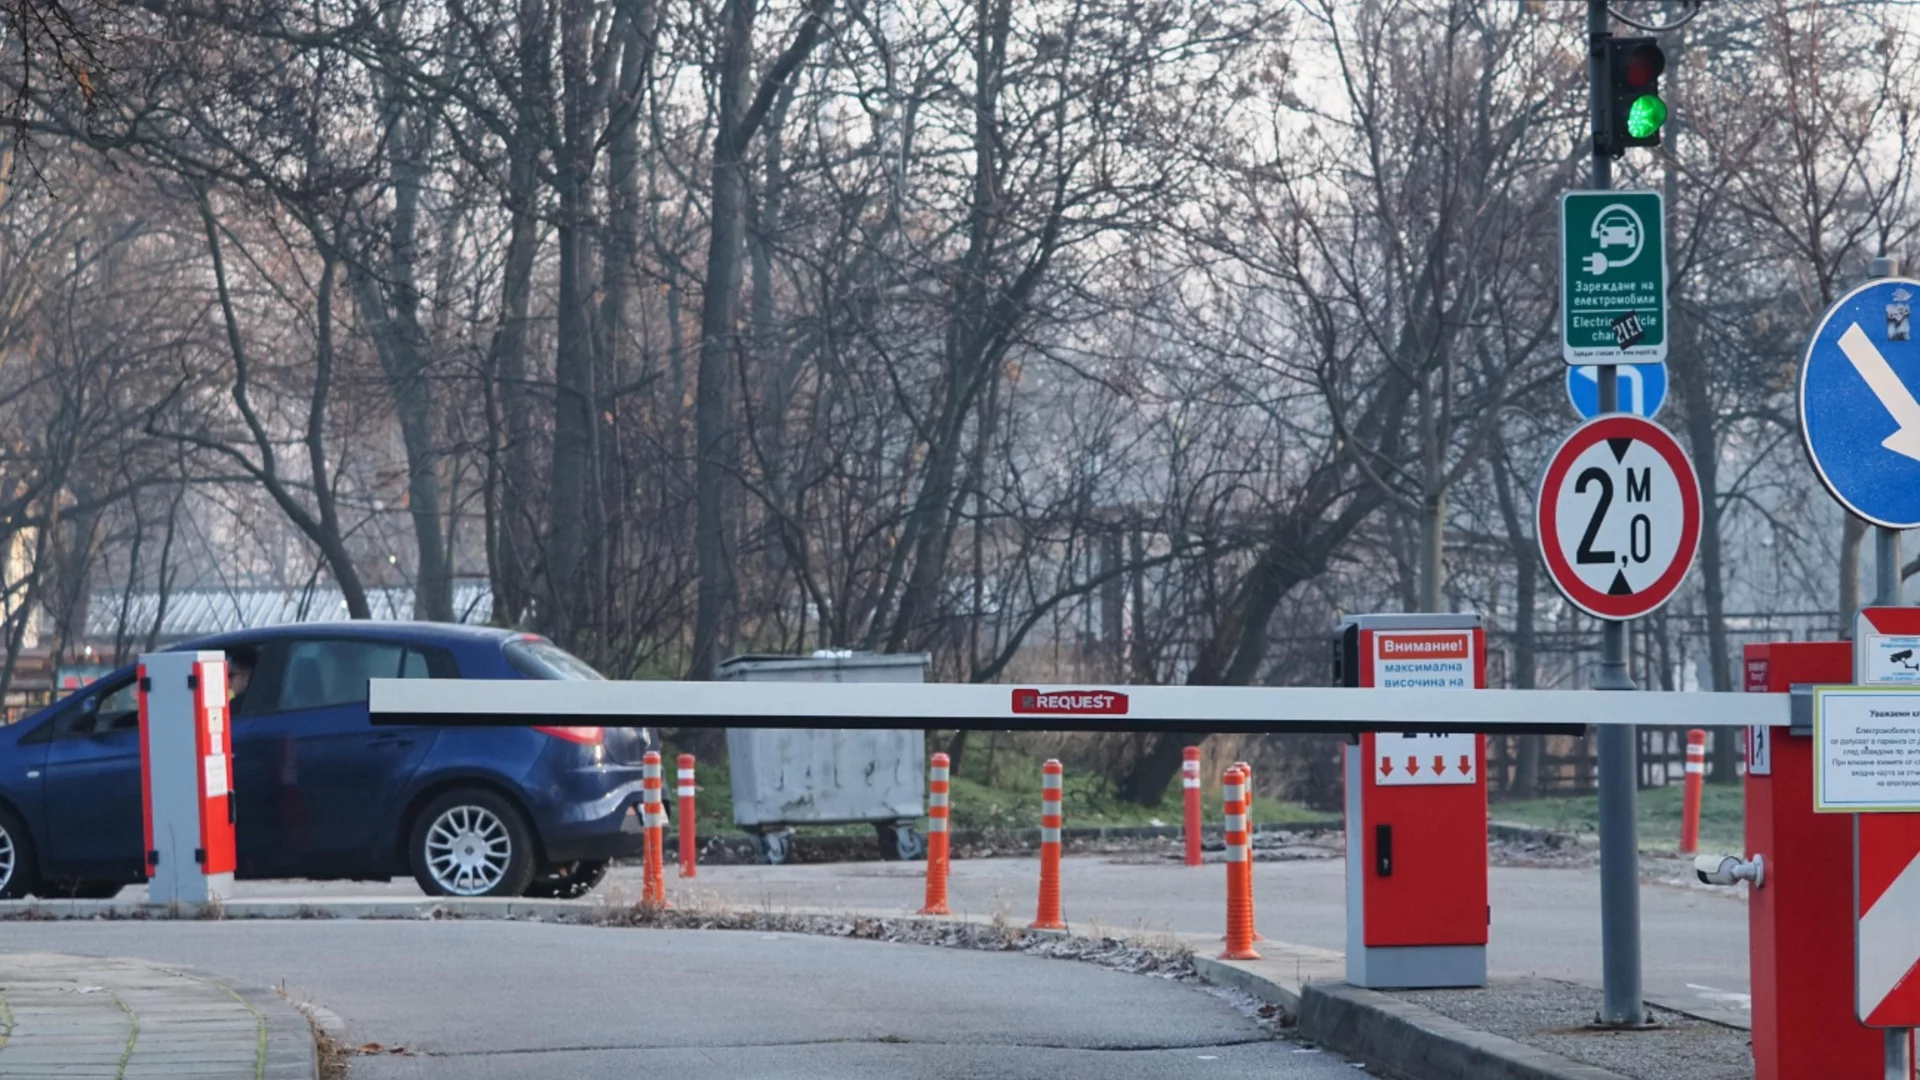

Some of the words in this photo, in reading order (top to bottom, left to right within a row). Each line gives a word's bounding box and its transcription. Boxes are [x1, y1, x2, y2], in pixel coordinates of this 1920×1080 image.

[1575, 280, 1636, 293] Зареждане
[1641, 281, 1654, 290] на
[1574, 294, 1656, 306] електромобили
[1384, 639, 1463, 653] Внимание!
[1384, 662, 1462, 672] максимална
[1384, 678, 1446, 688] височина
[1449, 677, 1464, 687] на
[1037, 695, 1115, 710] REQUEST
